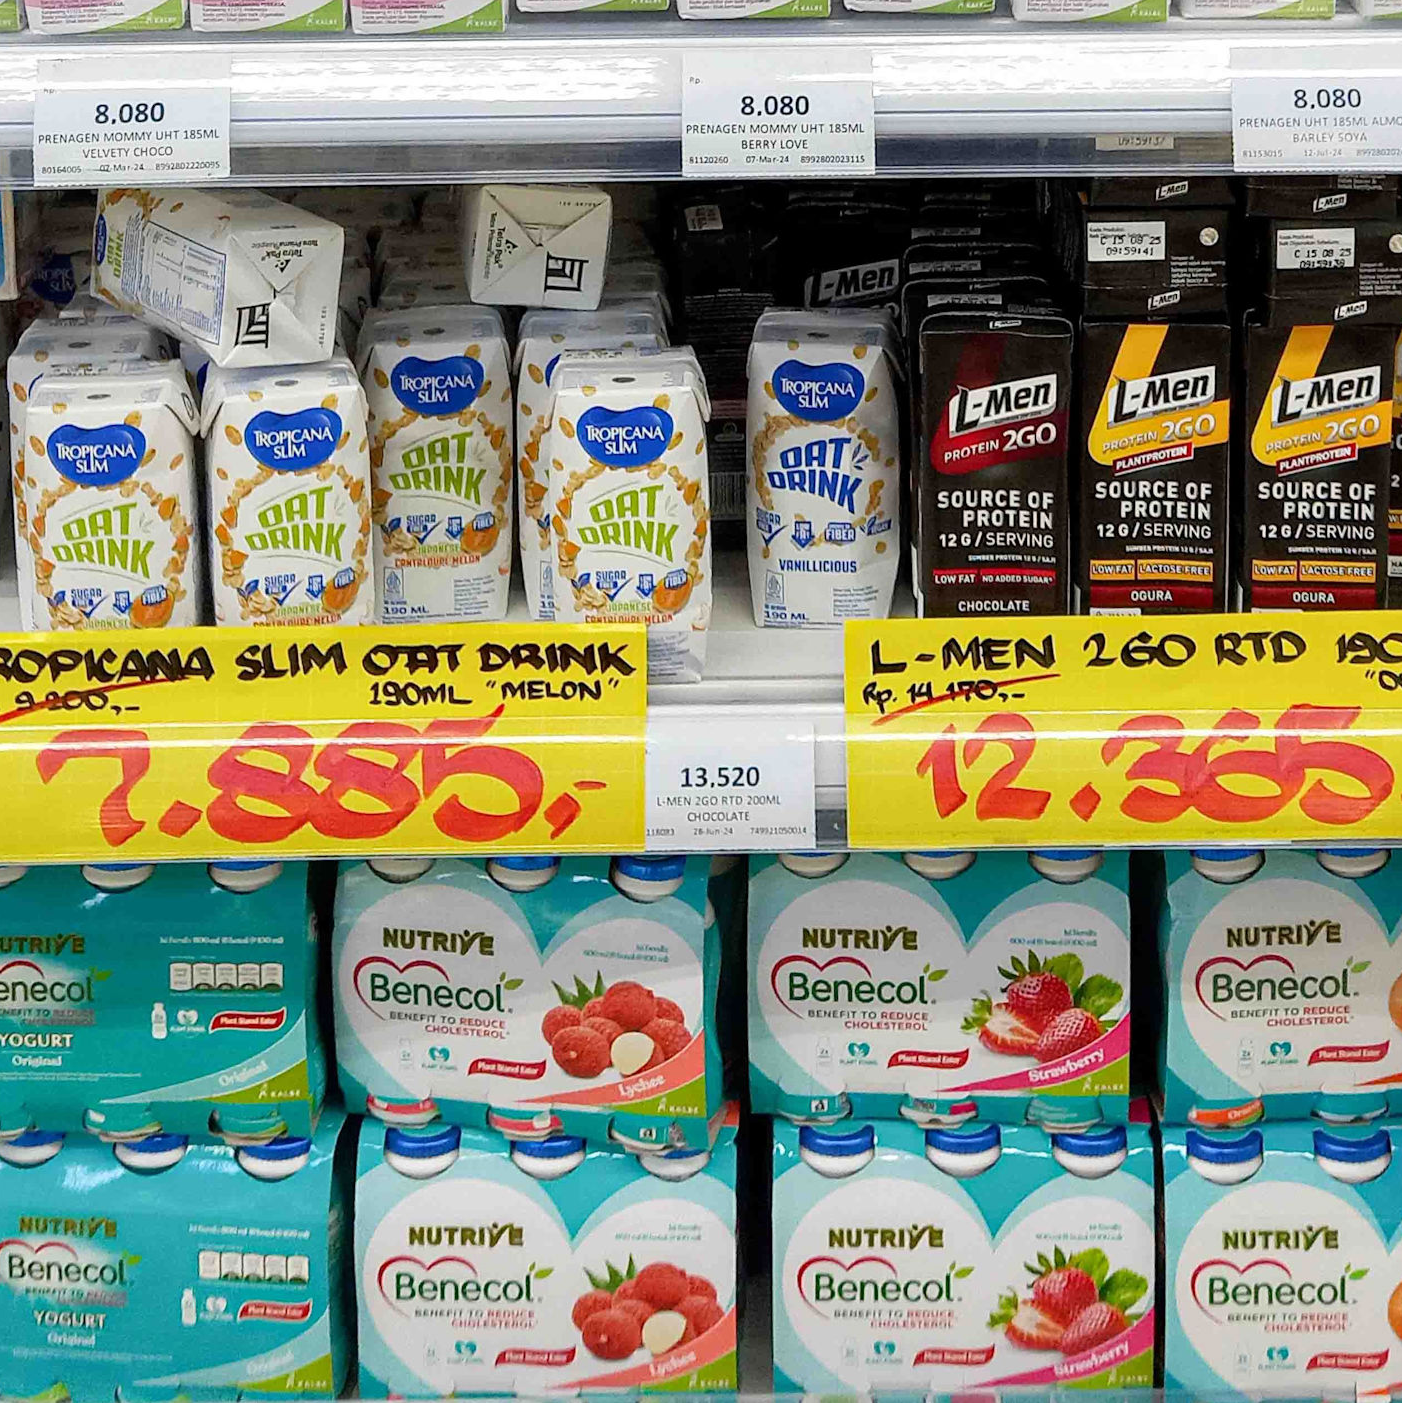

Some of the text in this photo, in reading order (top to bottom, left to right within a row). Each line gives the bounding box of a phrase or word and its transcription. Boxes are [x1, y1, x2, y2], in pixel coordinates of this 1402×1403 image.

[38, 128, 220, 145] PRENAGEN MOMMY UHT 185ML
[741, 138, 808, 151] BERRY LOVE
[1114, 372, 1214, 418] L-Men
[581, 425, 667, 449] TROPICANA
[605, 439, 639, 460] SLIM
[1095, 480, 1212, 501] SOURCE OF
[586, 484, 666, 522] OAT
[1120, 499, 1212, 522] PROTEIN
[576, 510, 677, 562] DRINK
[1092, 563, 1134, 578] LOW FAT
[1139, 563, 1212, 579] LACTOSE FREE
[1130, 589, 1172, 602] OGURA
[1084, 636, 1196, 667] 2GO
[1214, 631, 1306, 665] RTD
[236, 643, 347, 680] SLIM
[362, 643, 463, 676] OAT
[477, 643, 636, 677] DRINK
[369, 680, 472, 706] 190ML
[687, 811, 750, 822] CHOCOLATE
[371, 973, 509, 1013] Benecol
[788, 970, 933, 1006] Benecol
[390, 1012, 506, 1030] BENEFIT TO REDUCE
[1028, 1050, 1106, 1083] Strawberry
